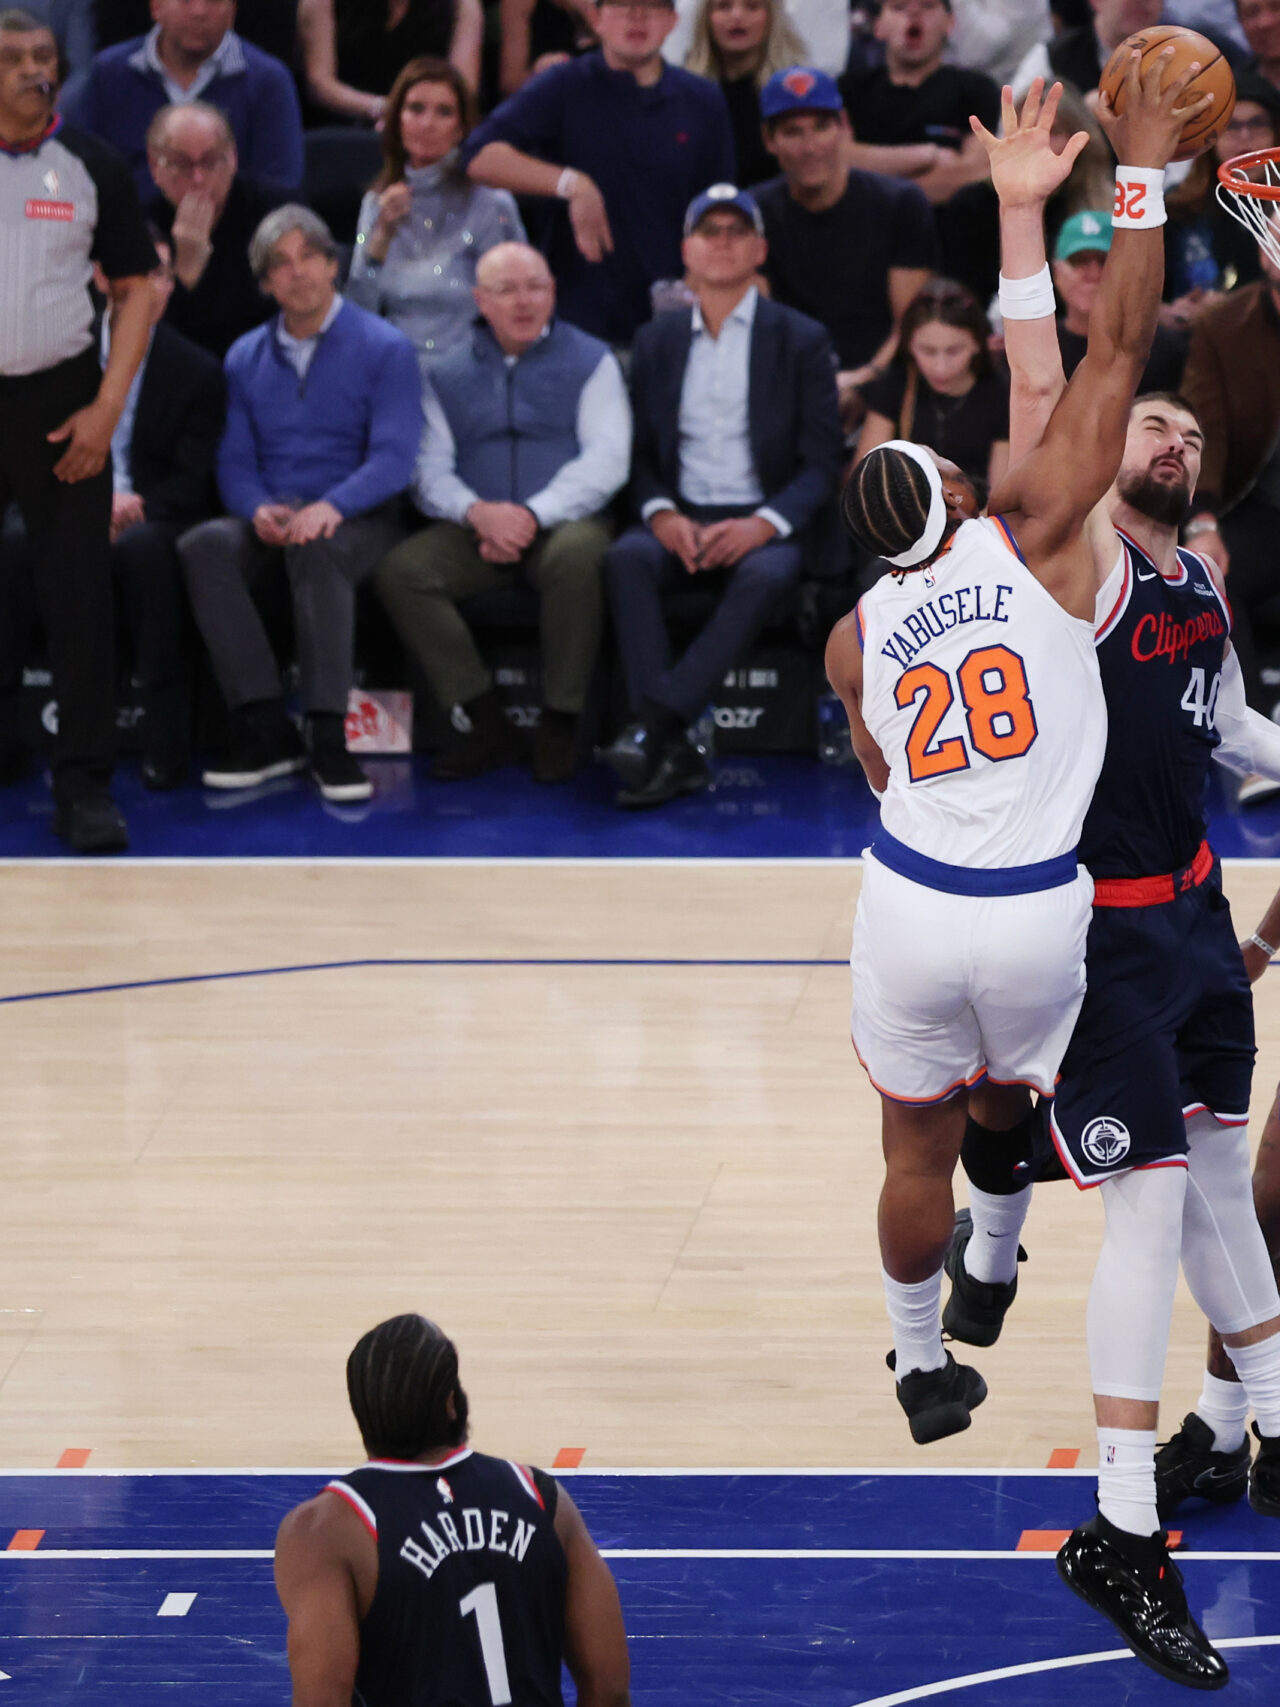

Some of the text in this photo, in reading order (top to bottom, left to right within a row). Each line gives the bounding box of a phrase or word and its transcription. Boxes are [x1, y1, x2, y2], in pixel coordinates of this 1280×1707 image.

[881, 584, 1013, 670] YABUSELE
[1131, 608, 1224, 665] Clippers
[893, 643, 1039, 784] 28
[400, 1507, 536, 1579] HARDEN
[459, 1581, 512, 1706] 1
